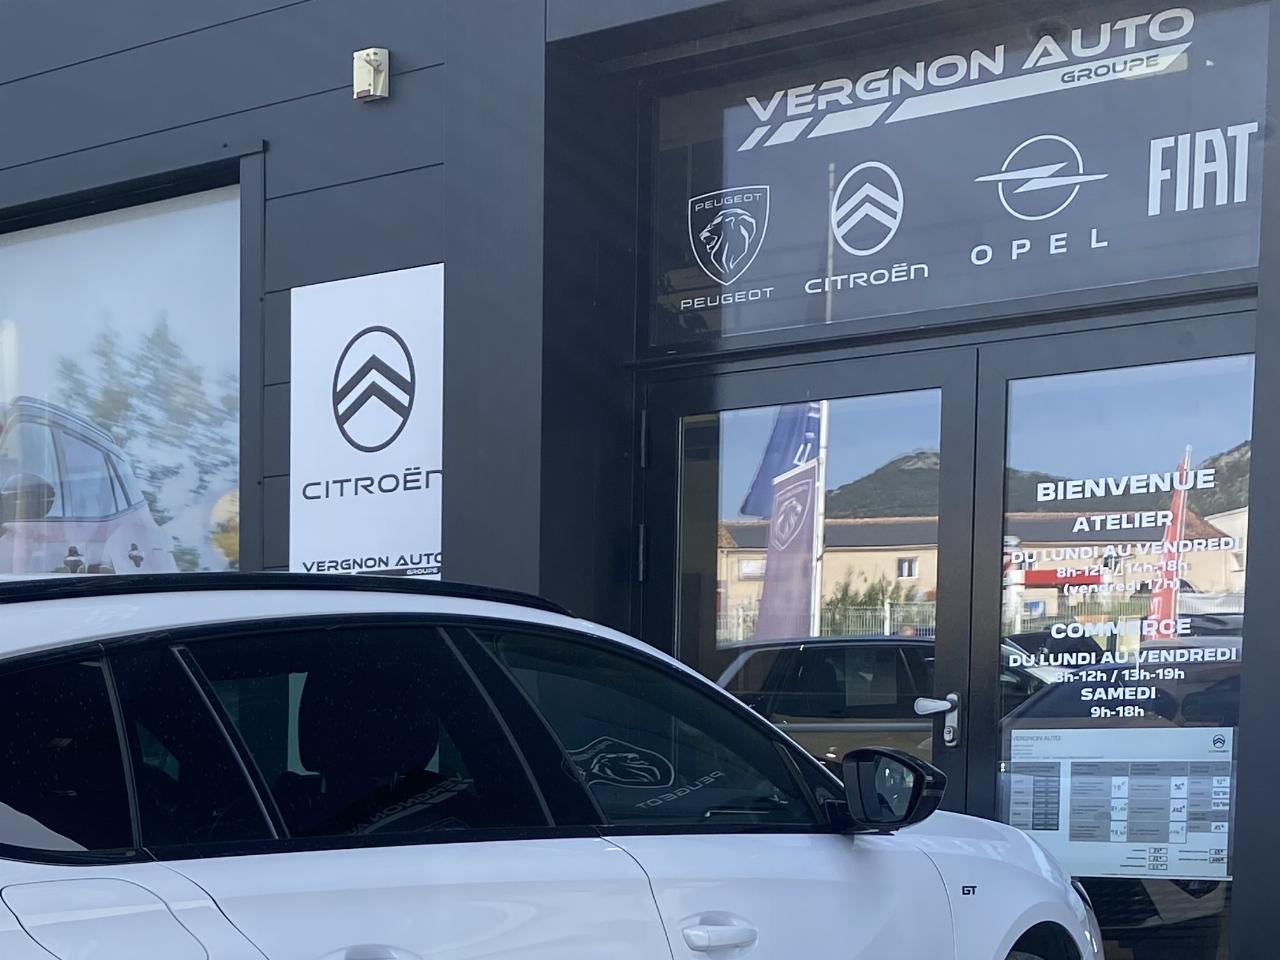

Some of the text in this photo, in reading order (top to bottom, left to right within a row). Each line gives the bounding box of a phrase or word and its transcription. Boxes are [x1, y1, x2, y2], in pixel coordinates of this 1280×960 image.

[745, 7, 1195, 122] VERGNON AUTO
[1060, 54, 1160, 84] GROUPE
[1148, 122, 1259, 216] FIAT
[695, 193, 762, 212] PEUGEOT
[970, 228, 1109, 266] OPEL
[680, 287, 775, 310] PEUGEOT
[1036, 468, 1216, 501] BIENVENUE
[1072, 510, 1173, 533] ATELIER
[302, 556, 390, 572] VERGNON
[1011, 551, 1037, 564] DU
[1040, 546, 1099, 561] LUNDI
[1103, 543, 1131, 558] AU
[1009, 647, 1237, 667] DU LUNDI AU VENDREDI
[1121, 668, 1185, 681] 13h-19h
[1080, 686, 1156, 701] SAMEDI
[1090, 706, 1145, 718] 9h-18h
[961, 885, 977, 896] GT
